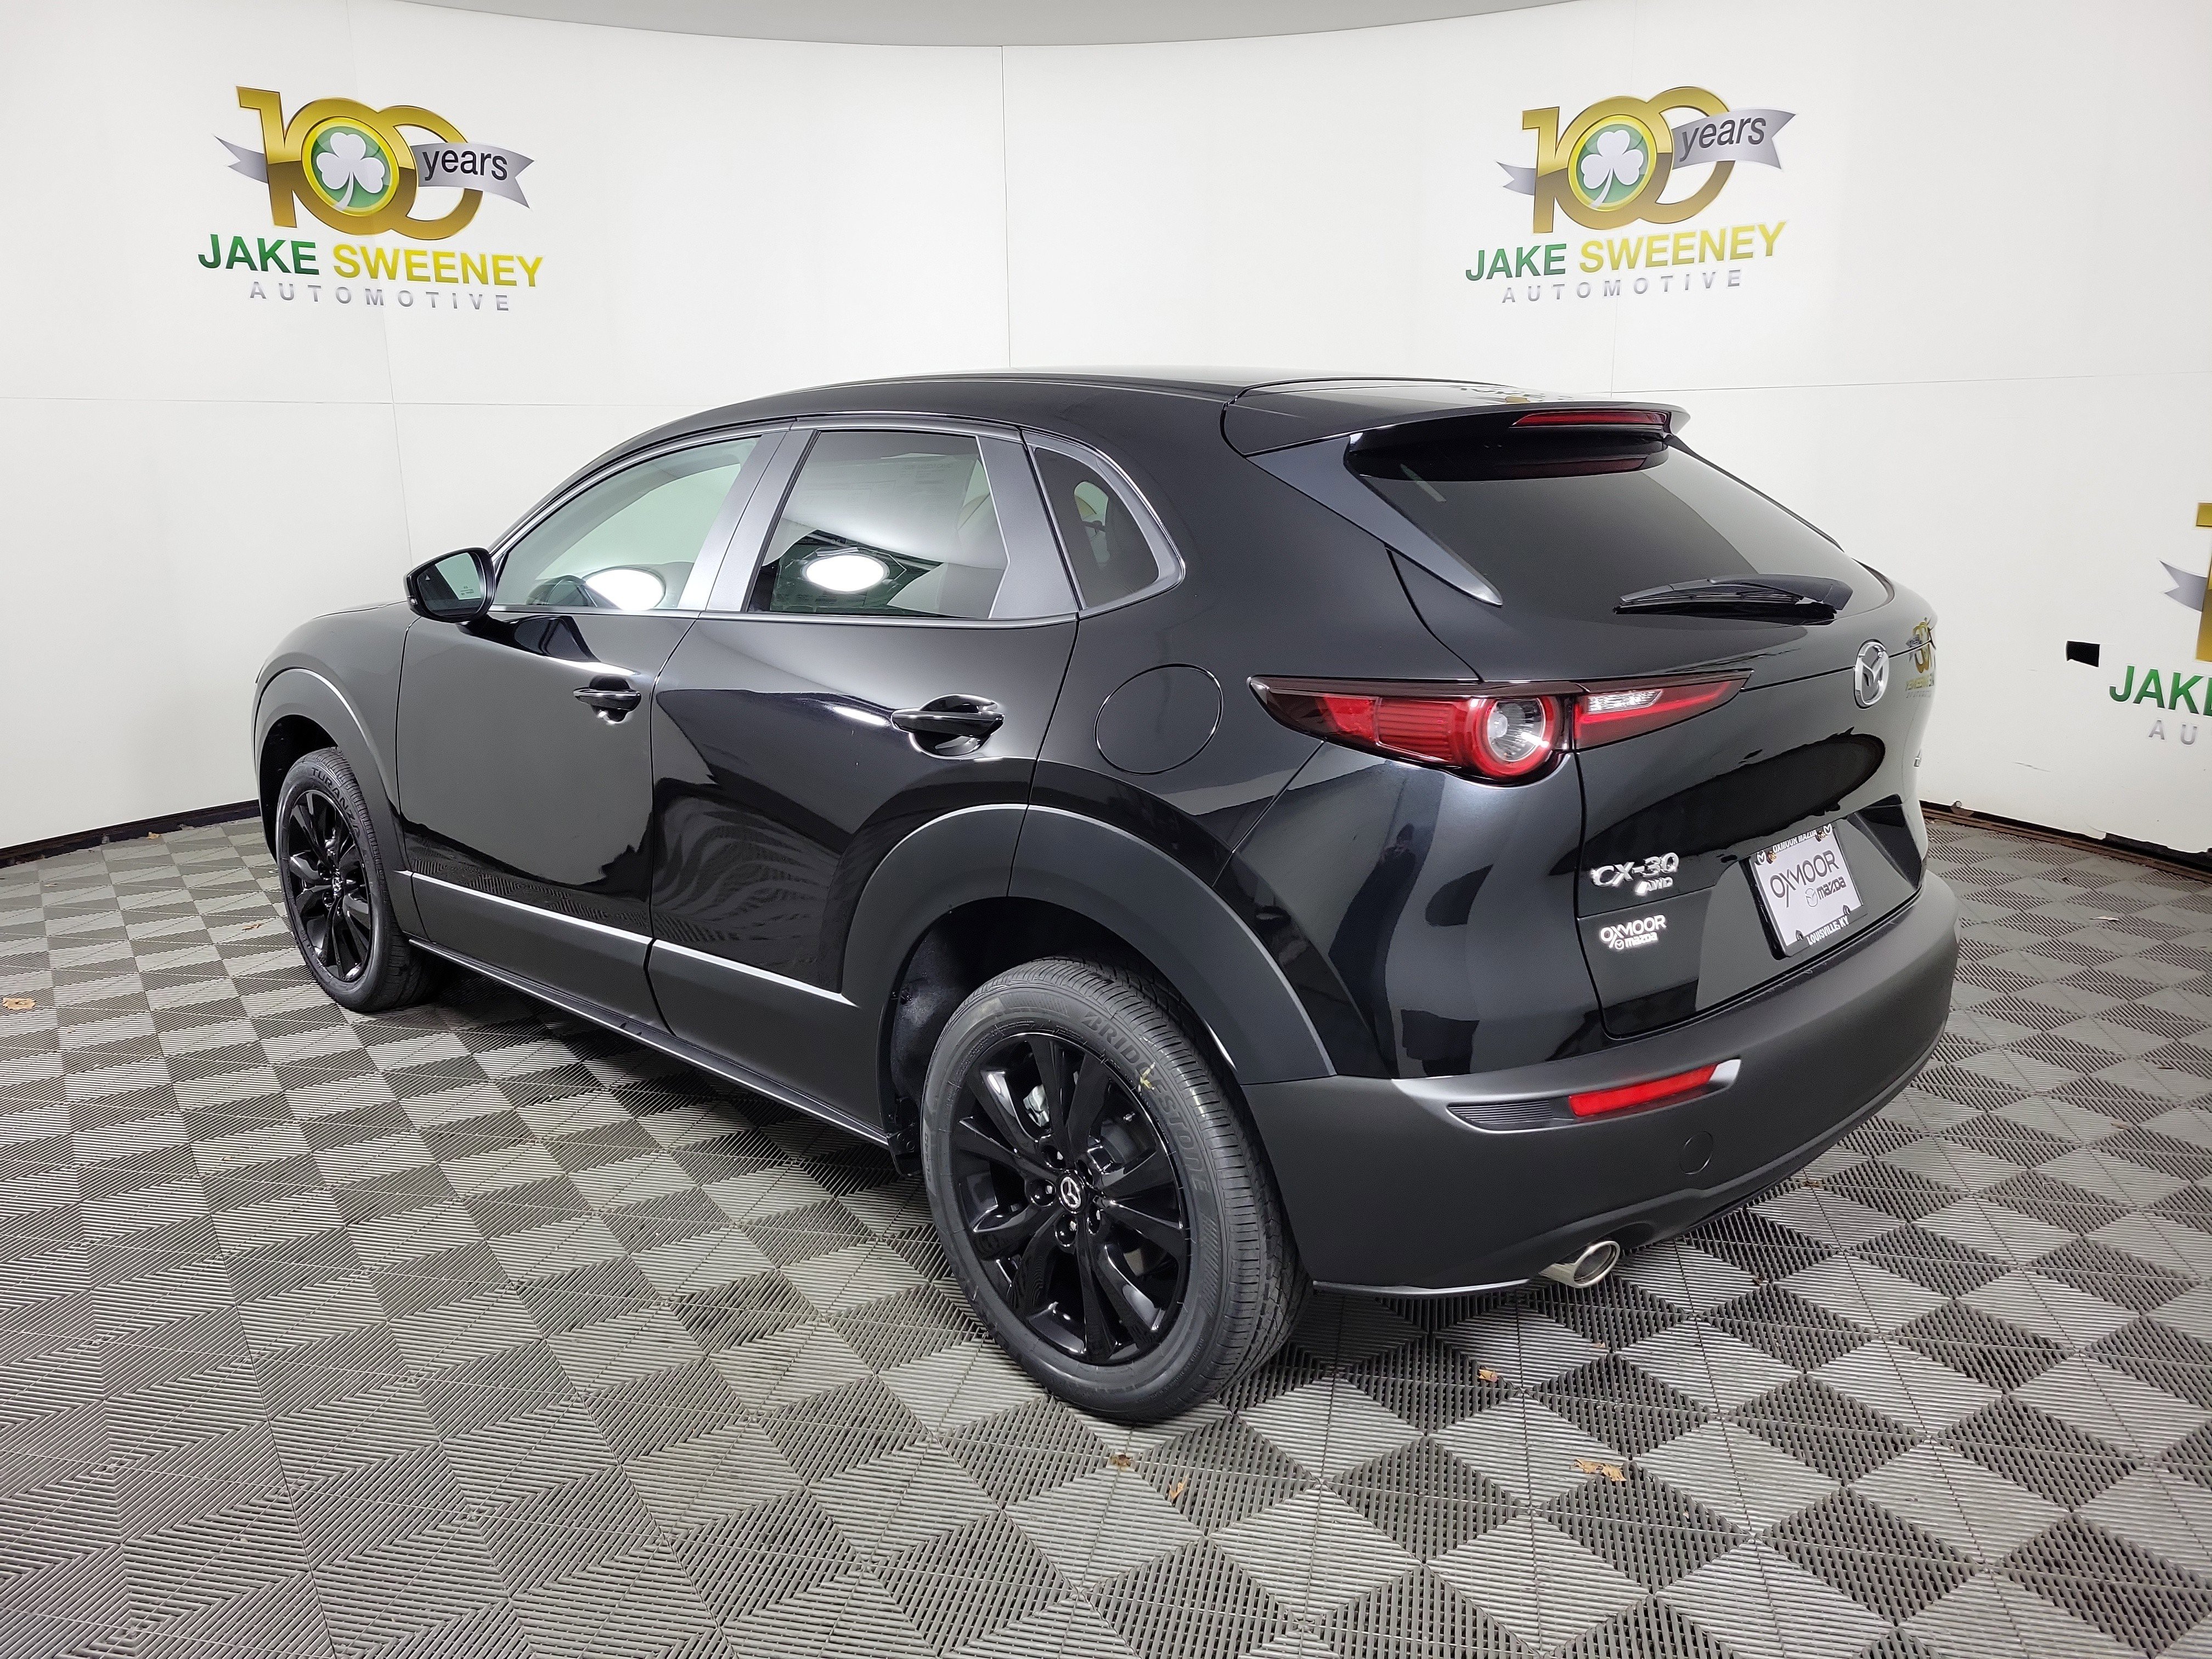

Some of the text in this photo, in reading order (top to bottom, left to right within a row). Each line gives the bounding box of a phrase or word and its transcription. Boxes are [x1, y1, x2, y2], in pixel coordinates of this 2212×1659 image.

[236, 86, 509, 240] 100 years
[1522, 86, 1767, 233] 100 years
[198, 234, 544, 288] JAKE SWEENEY
[1465, 221, 1786, 281] JAKE SWEENEY
[250, 281, 510, 312] AUTOMOTIVE
[1502, 269, 1741, 304] AUTOMOTIVE
[311, 768, 360, 838] TURANZA
[1591, 852, 1679, 887] CX-30
[1769, 850, 1839, 908] OXMOOR
[1600, 915, 1667, 948] OXMOOR
[1838, 915, 1850, 928] KY
